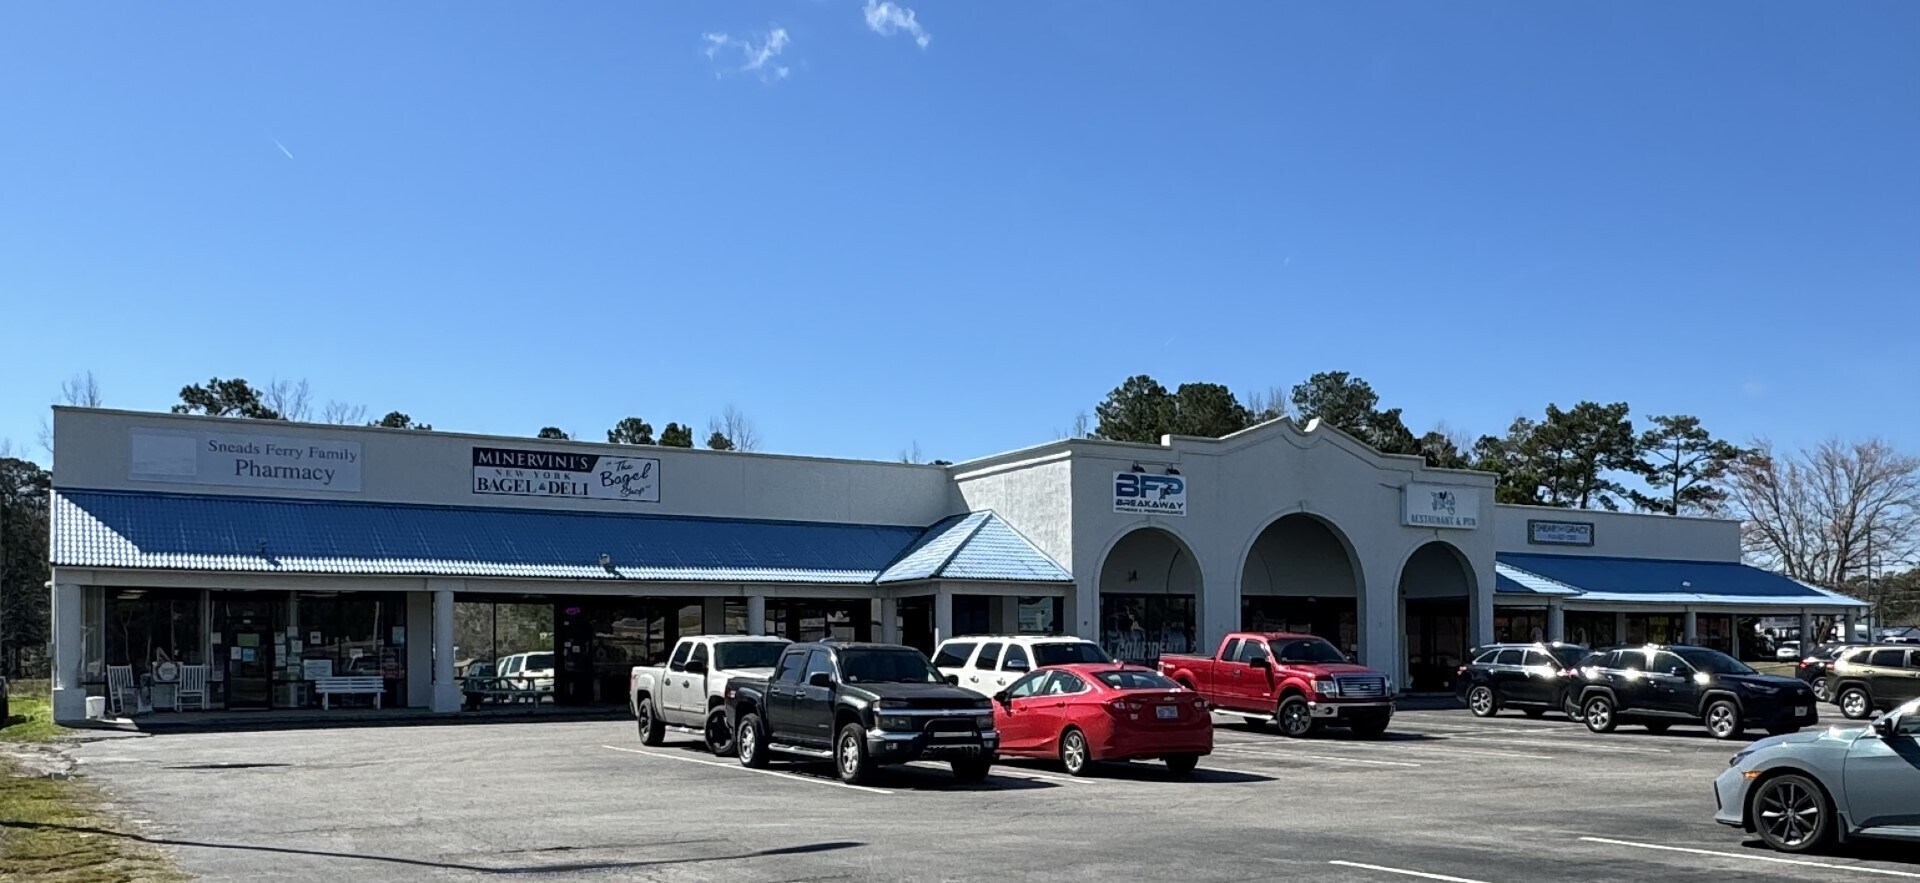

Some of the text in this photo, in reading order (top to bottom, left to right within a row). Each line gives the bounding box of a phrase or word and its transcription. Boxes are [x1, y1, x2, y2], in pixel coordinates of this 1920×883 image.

[208, 439, 357, 462] Sneads Ferry Family
[478, 450, 588, 469] MINERVINI'S
[235, 459, 335, 485] Pharmacy
[495, 468, 572, 480] NEW YORK
[600, 463, 652, 488] Bagel
[477, 477, 588, 496] BAGEL & DELI
[1116, 473, 1184, 498] BFP
[1116, 499, 1184, 510] BREAKAWAY
[1411, 514, 1454, 525] RESTAURANT
[1463, 517, 1476, 526] PUB
